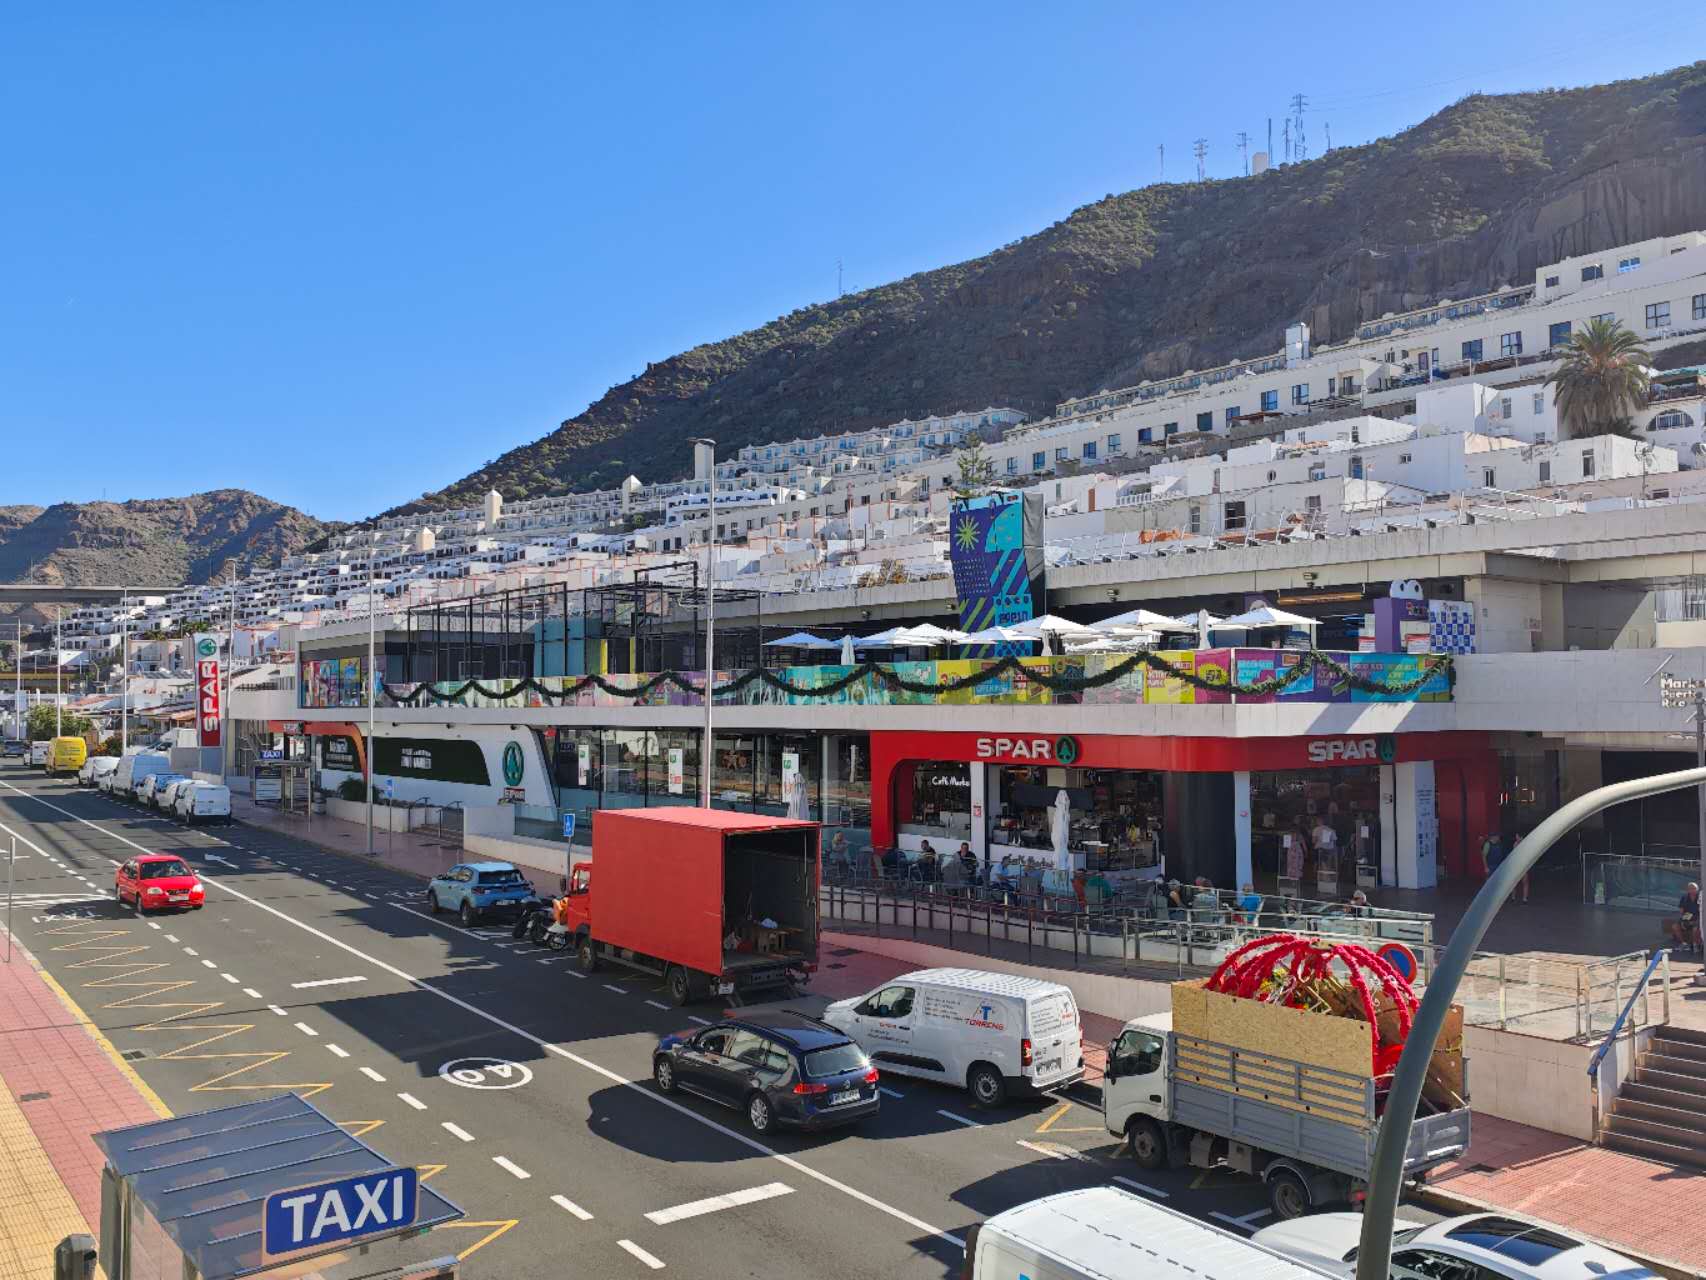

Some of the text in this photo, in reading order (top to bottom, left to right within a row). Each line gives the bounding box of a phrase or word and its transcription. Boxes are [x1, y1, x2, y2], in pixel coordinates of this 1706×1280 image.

[202, 662, 218, 732] SPAR
[976, 738, 1051, 759] SPAR
[1308, 739, 1377, 761] SPAR
[453, 1064, 512, 1083] 40
[281, 1176, 403, 1242] TAXI
